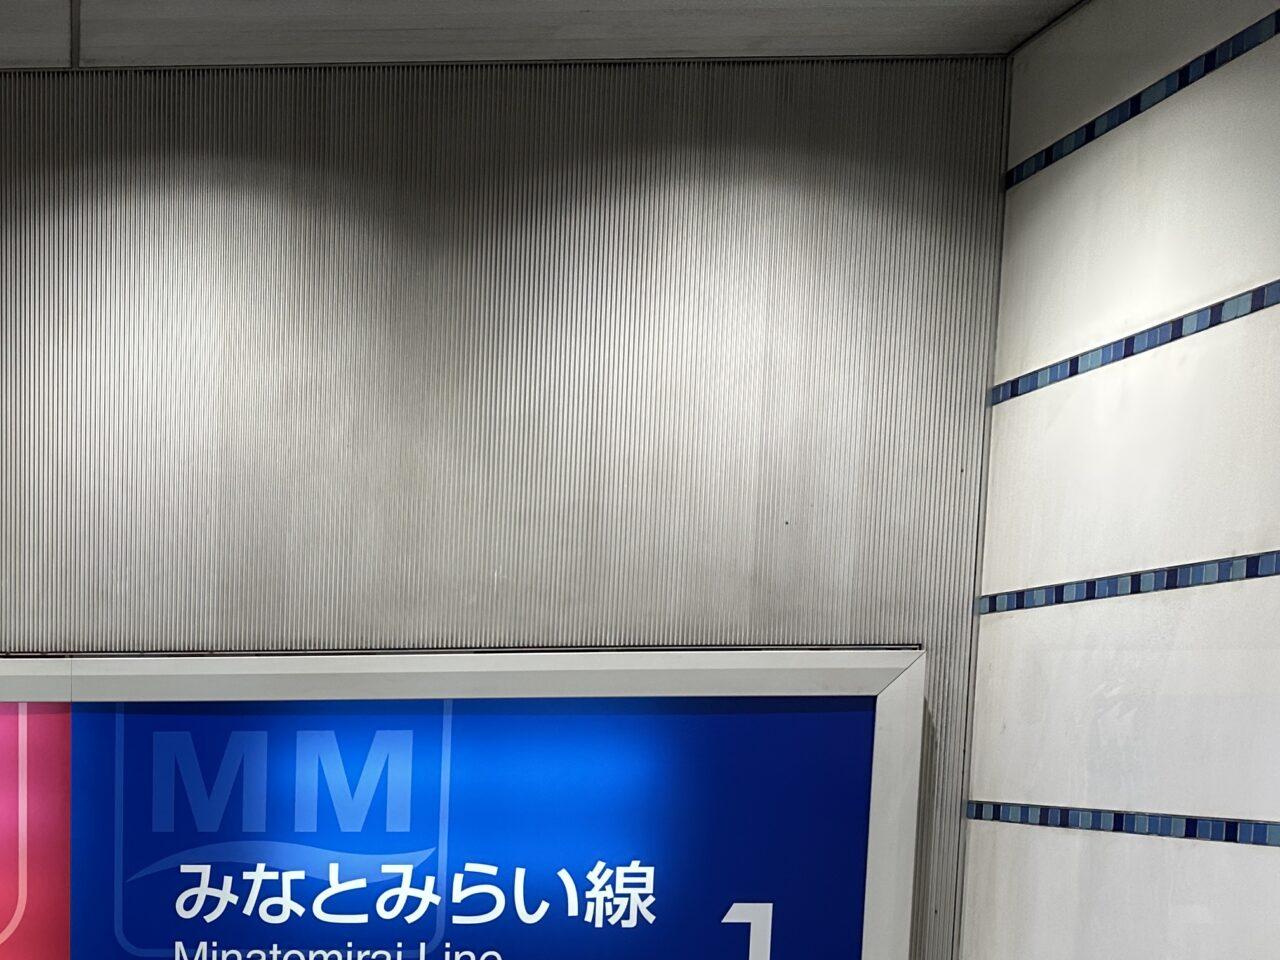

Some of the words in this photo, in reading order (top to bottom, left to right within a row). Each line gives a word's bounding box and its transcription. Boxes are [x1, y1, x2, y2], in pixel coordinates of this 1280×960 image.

[151, 729, 414, 833] MM
[175, 859, 657, 928] みなとみらい線
